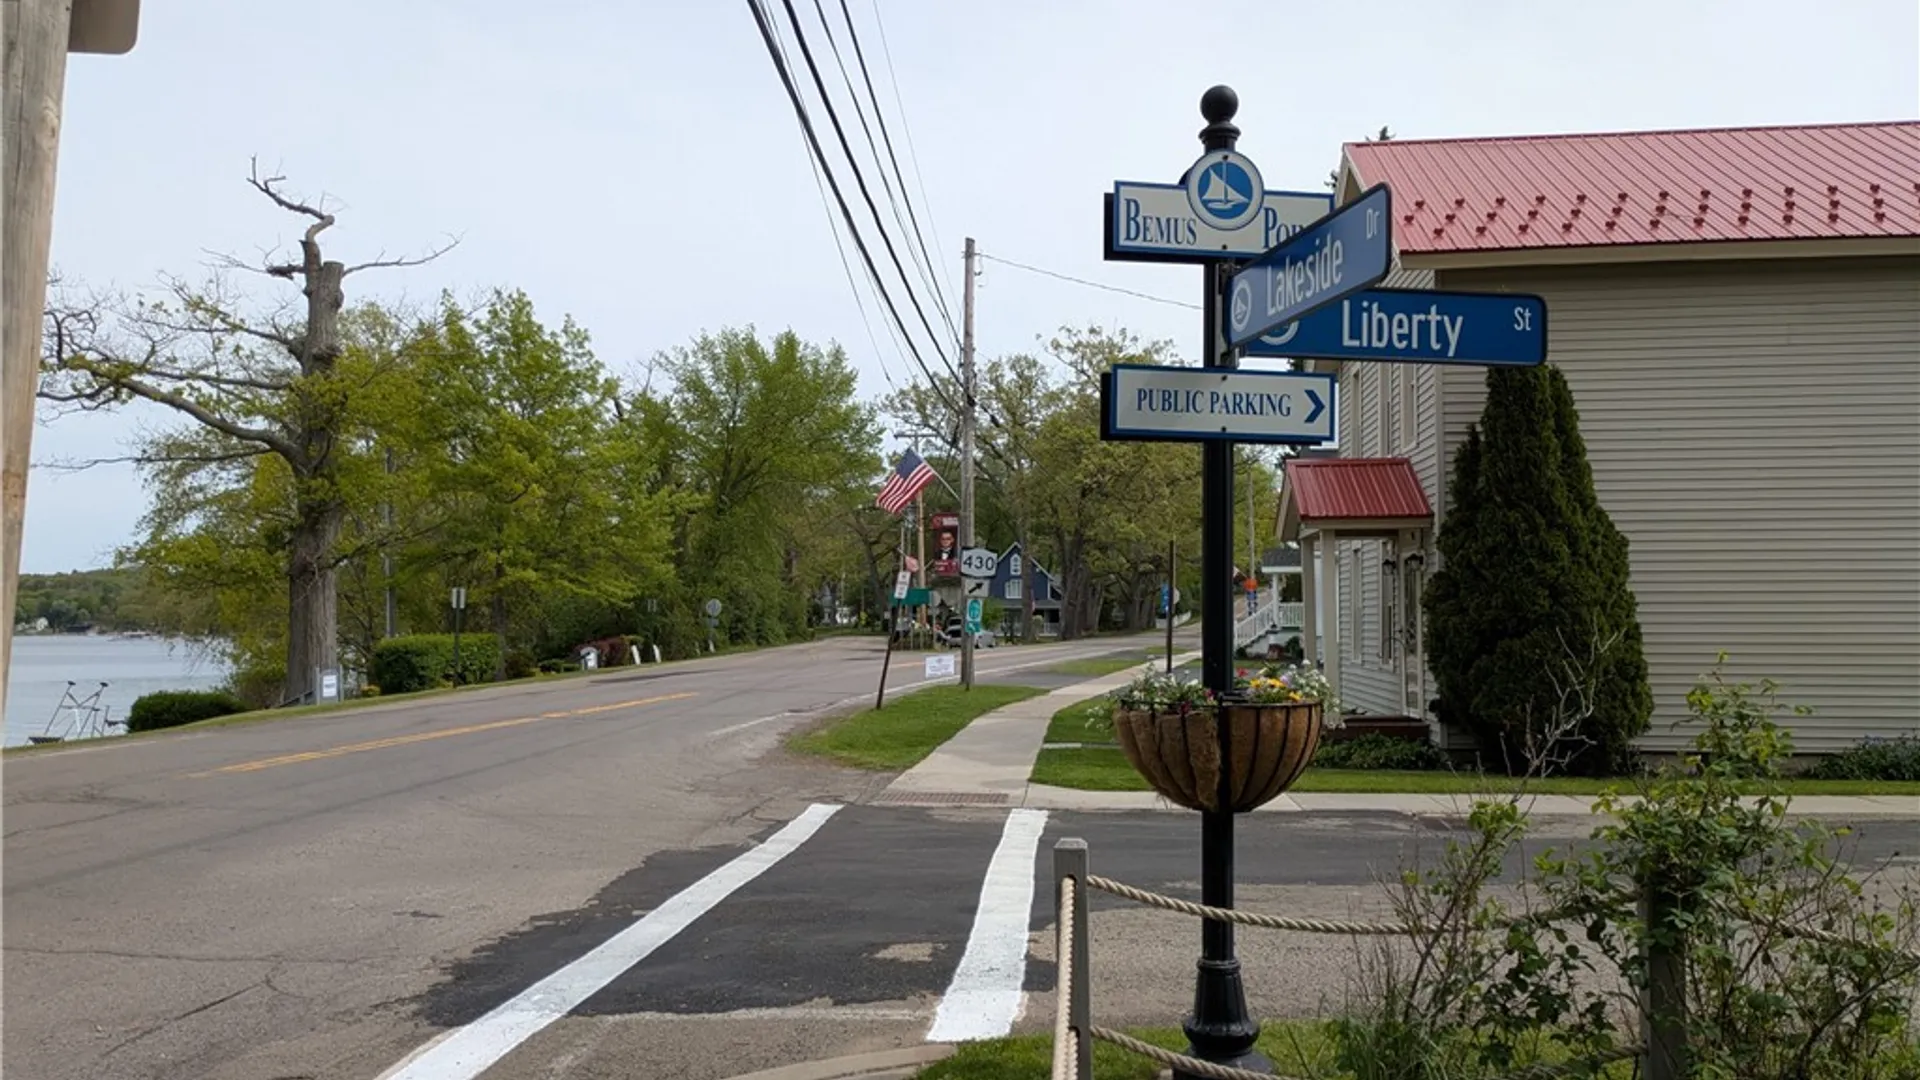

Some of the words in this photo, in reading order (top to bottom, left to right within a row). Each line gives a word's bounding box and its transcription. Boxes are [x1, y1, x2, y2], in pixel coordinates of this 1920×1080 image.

[1123, 198, 1198, 245] BEMUS
[1263, 207, 1305, 249] PO
[1265, 233, 1344, 316] Lakeside
[1366, 208, 1381, 240] Dr
[1342, 300, 1463, 357] Liberty
[1514, 306, 1532, 331] St
[1136, 388, 1205, 413] PUBLIC
[1210, 391, 1292, 417] PARKING
[962, 555, 995, 571] 430
